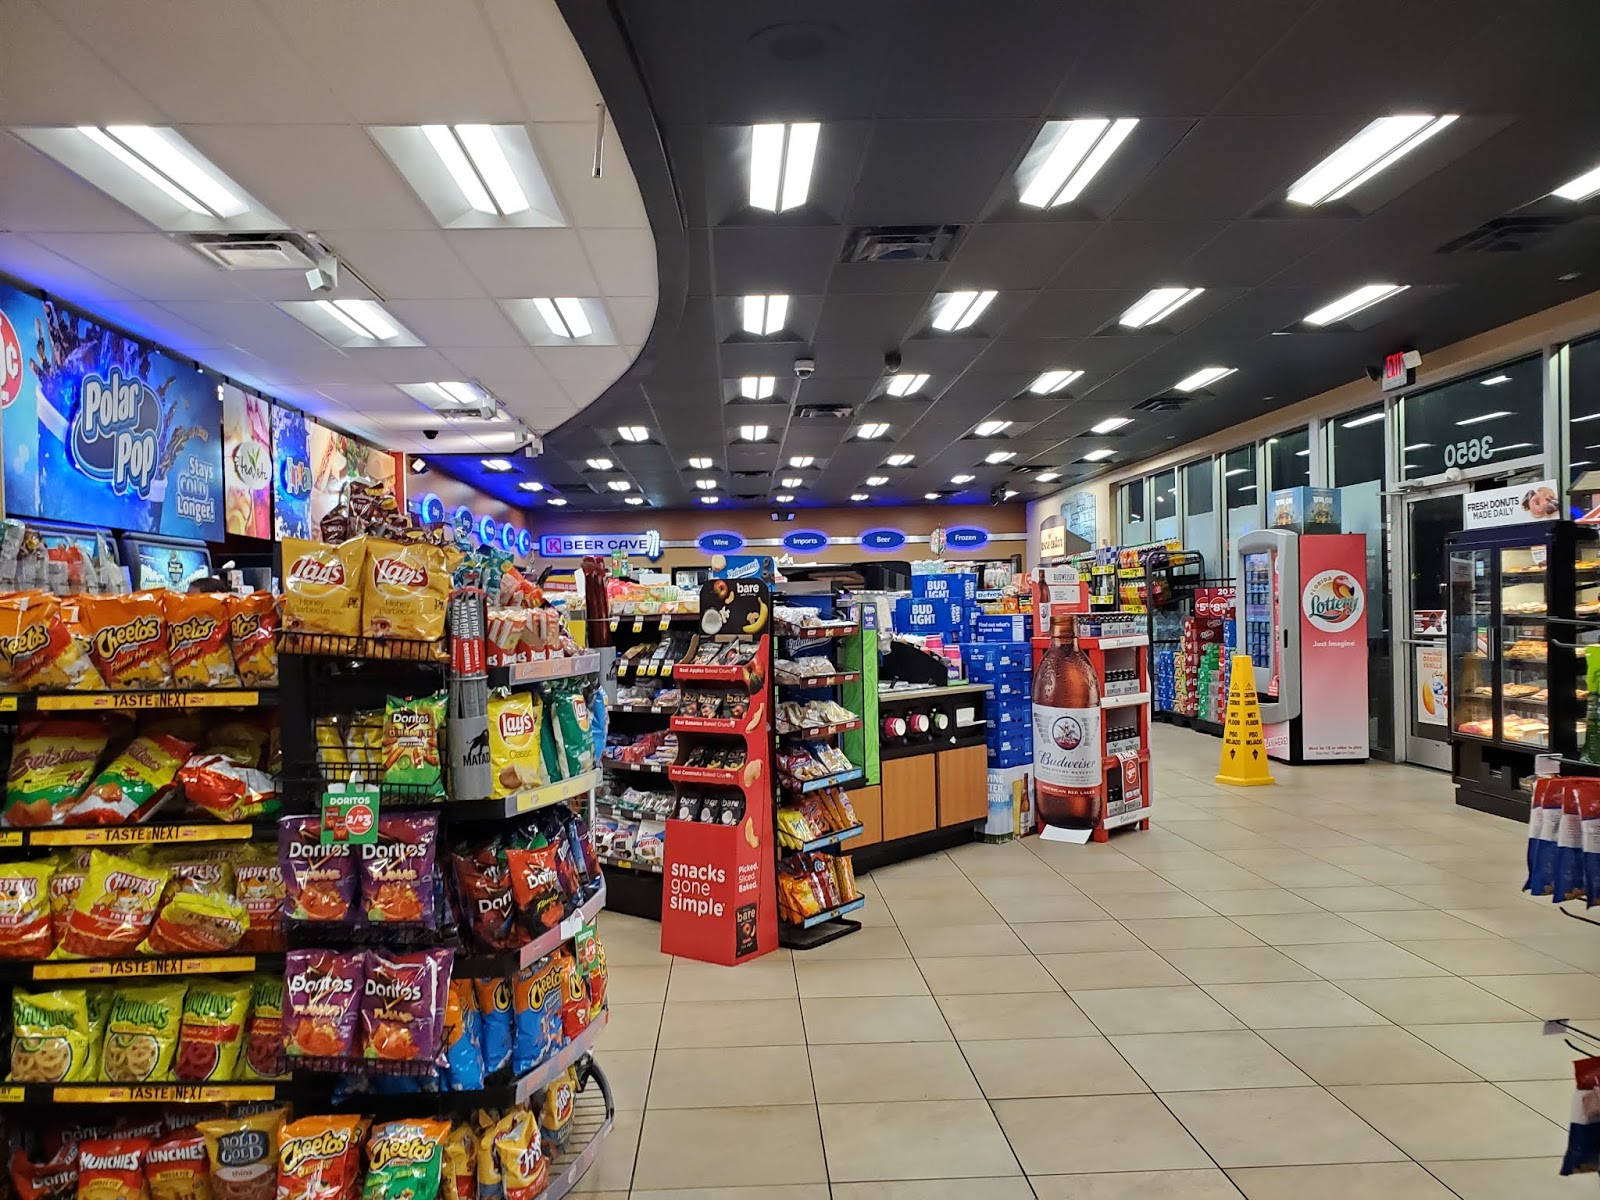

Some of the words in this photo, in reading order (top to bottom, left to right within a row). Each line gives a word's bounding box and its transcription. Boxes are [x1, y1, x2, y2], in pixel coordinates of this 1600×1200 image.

[1386, 352, 1403, 378] EXIT
[84, 370, 140, 432] Polar
[116, 432, 153, 488] Pop
[188, 456, 213, 479] Stays
[179, 477, 207, 498] COLD
[176, 494, 215, 523] Longer!
[1467, 500, 1489, 512] FRESH
[1490, 496, 1520, 509] DONUTS
[1472, 509, 1492, 520] MADE
[1493, 507, 1515, 518] DAILY
[563, 540, 604, 550] BEER
[607, 539, 648, 549] CAVE
[713, 538, 729, 546] Wine
[793, 537, 818, 546] Imports
[876, 535, 891, 543] Beer
[737, 583, 760, 593] bare
[927, 580, 948, 590] BUD
[1217, 588, 1229, 596] 20
[1310, 576, 1333, 595] FLORIDA
[925, 590, 950, 599] LIGHT
[293, 605, 331, 615] Barbecue
[300, 598, 325, 608] Honey
[385, 599, 411, 609] Honey
[912, 604, 933, 614] BUD
[1308, 594, 1359, 620] Lottery
[460, 602, 470, 640] MATADOR
[909, 614, 936, 625] LIGHT
[96, 616, 159, 660] Cheetos
[1328, 640, 1355, 648] Imagine
[113, 694, 153, 707] TASTE
[159, 693, 187, 706] NEXT
[392, 713, 429, 723] Doritos
[463, 752, 491, 767] MATAD
[509, 749, 532, 760] Classic
[1039, 749, 1096, 769] Budweiser
[329, 796, 371, 806] DORITOS
[105, 829, 145, 841] TASTE
[151, 827, 180, 840] NEXT
[289, 842, 350, 859] Doritos
[362, 843, 427, 860] Doritos
[671, 862, 726, 883] snacks
[671, 878, 711, 896] gone
[669, 893, 724, 917] simple
[736, 908, 756, 923] bare
[109, 962, 150, 974] TASTE
[156, 959, 183, 973] NEXT
[292, 975, 353, 994] Doritos
[365, 978, 422, 1001] Doritos
[129, 1087, 169, 1099] TASTE
[175, 1086, 202, 1099] NEXT
[221, 1131, 261, 1149] ROLD
[221, 1145, 264, 1164] GOLD
[281, 1130, 347, 1172] Cheetos
[369, 1138, 436, 1172] Cheetos
[80, 1149, 141, 1172] MUNCHIES
